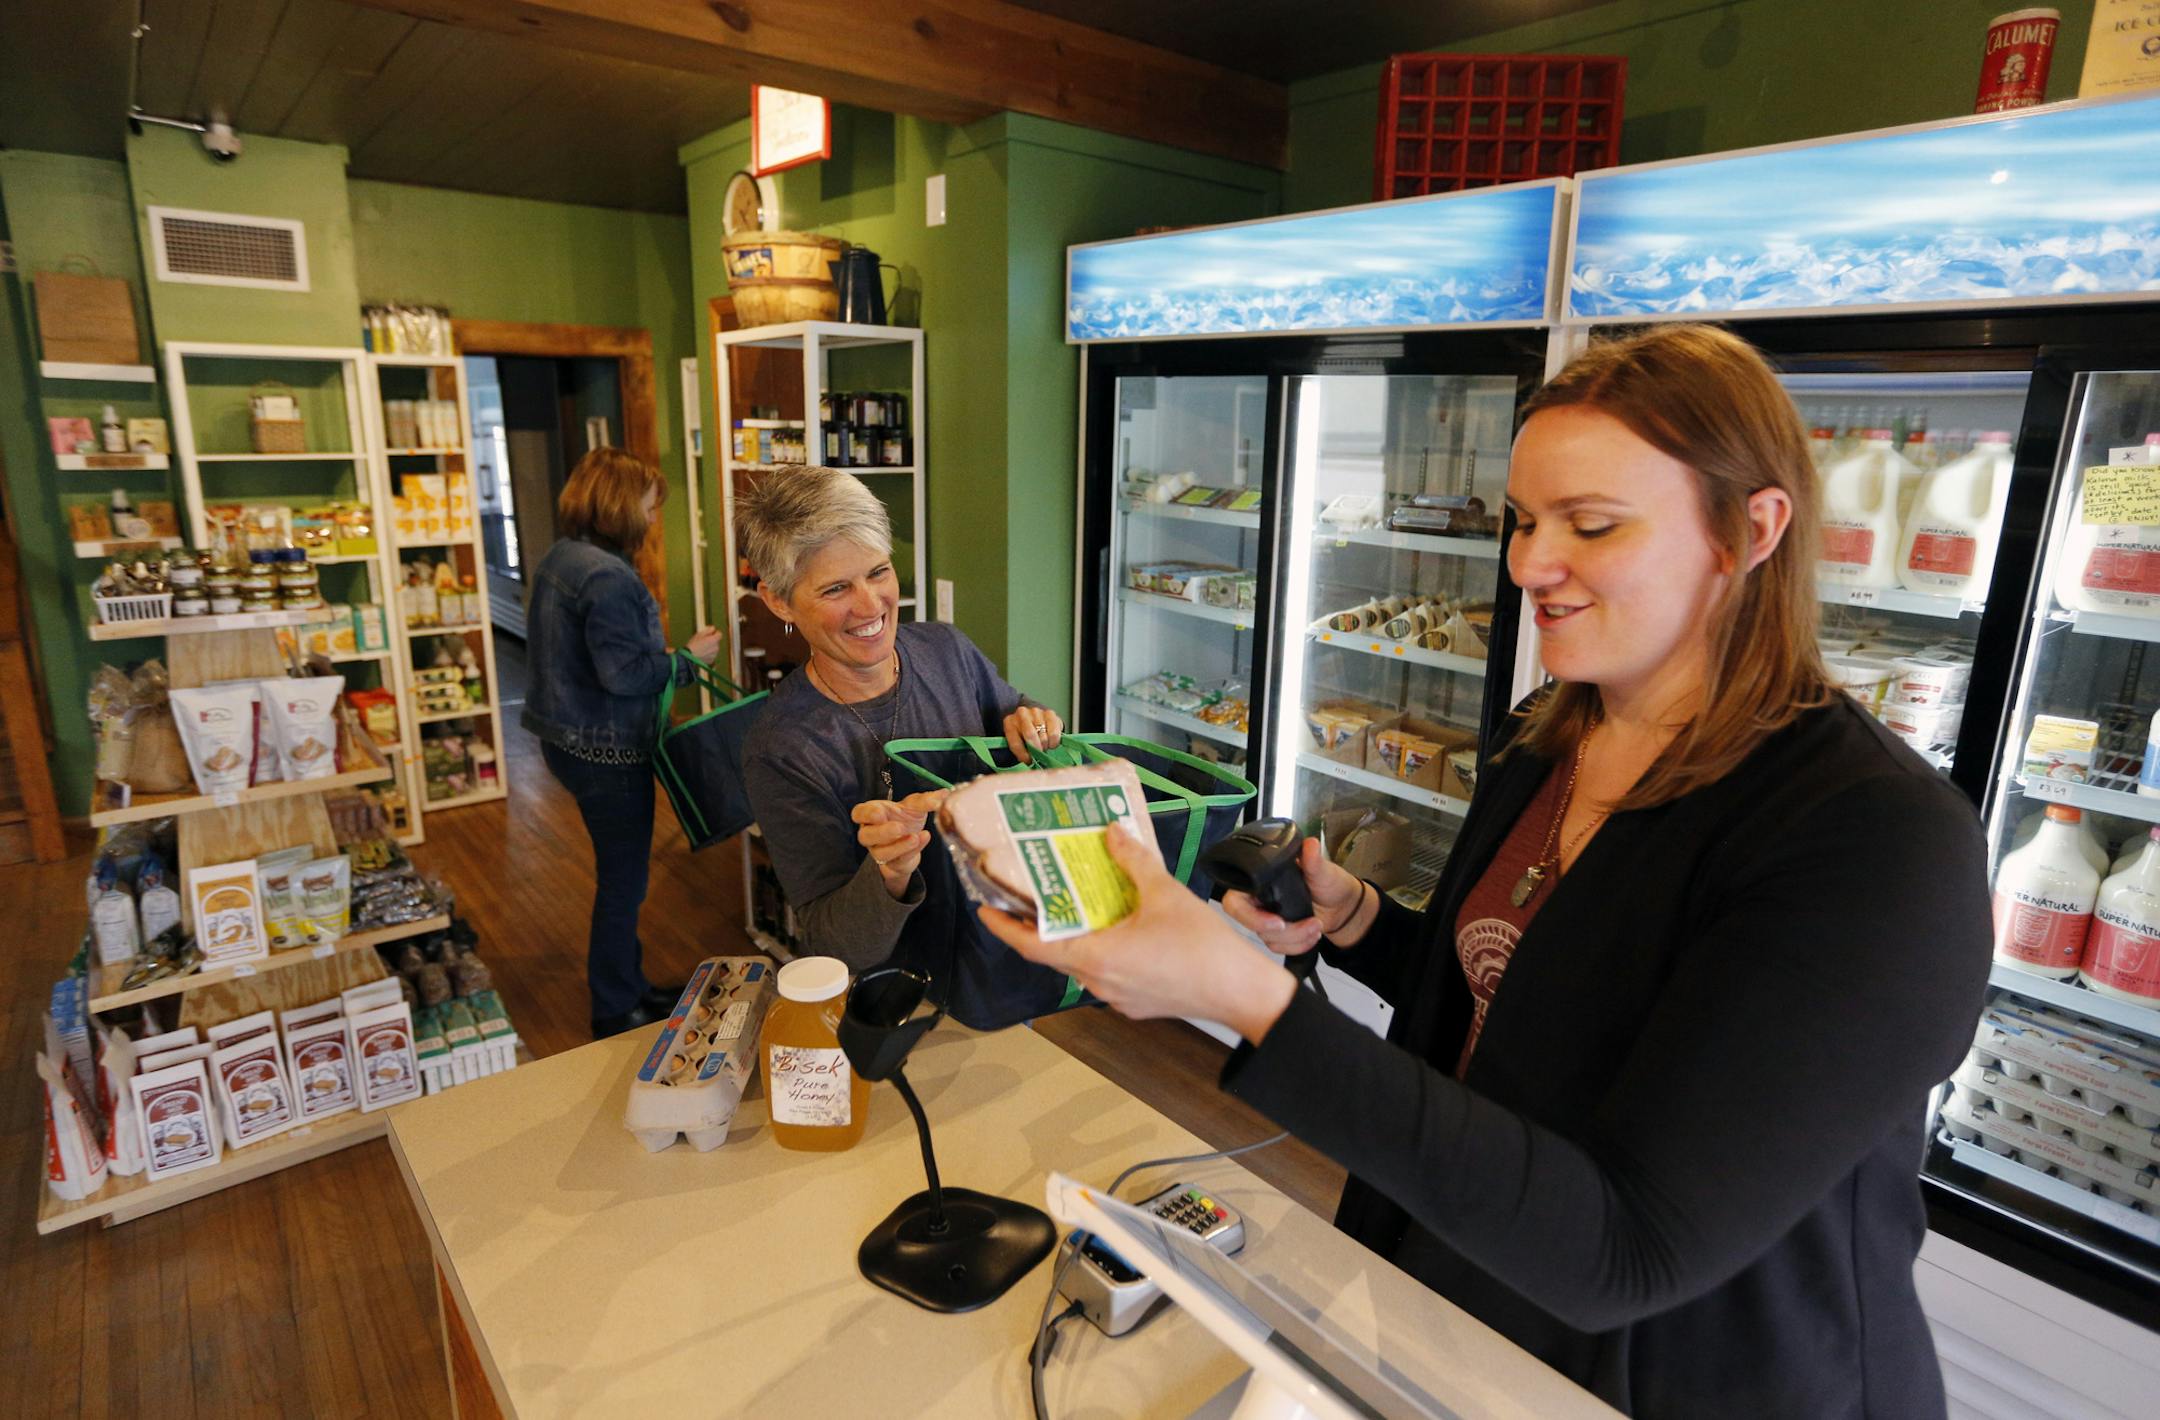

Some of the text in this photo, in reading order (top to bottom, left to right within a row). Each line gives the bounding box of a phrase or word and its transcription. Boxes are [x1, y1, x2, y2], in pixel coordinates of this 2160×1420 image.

[1986, 23, 2056, 55] CALUMET
[793, 1077, 829, 1089] Pure
[788, 1088, 835, 1105] Honey
